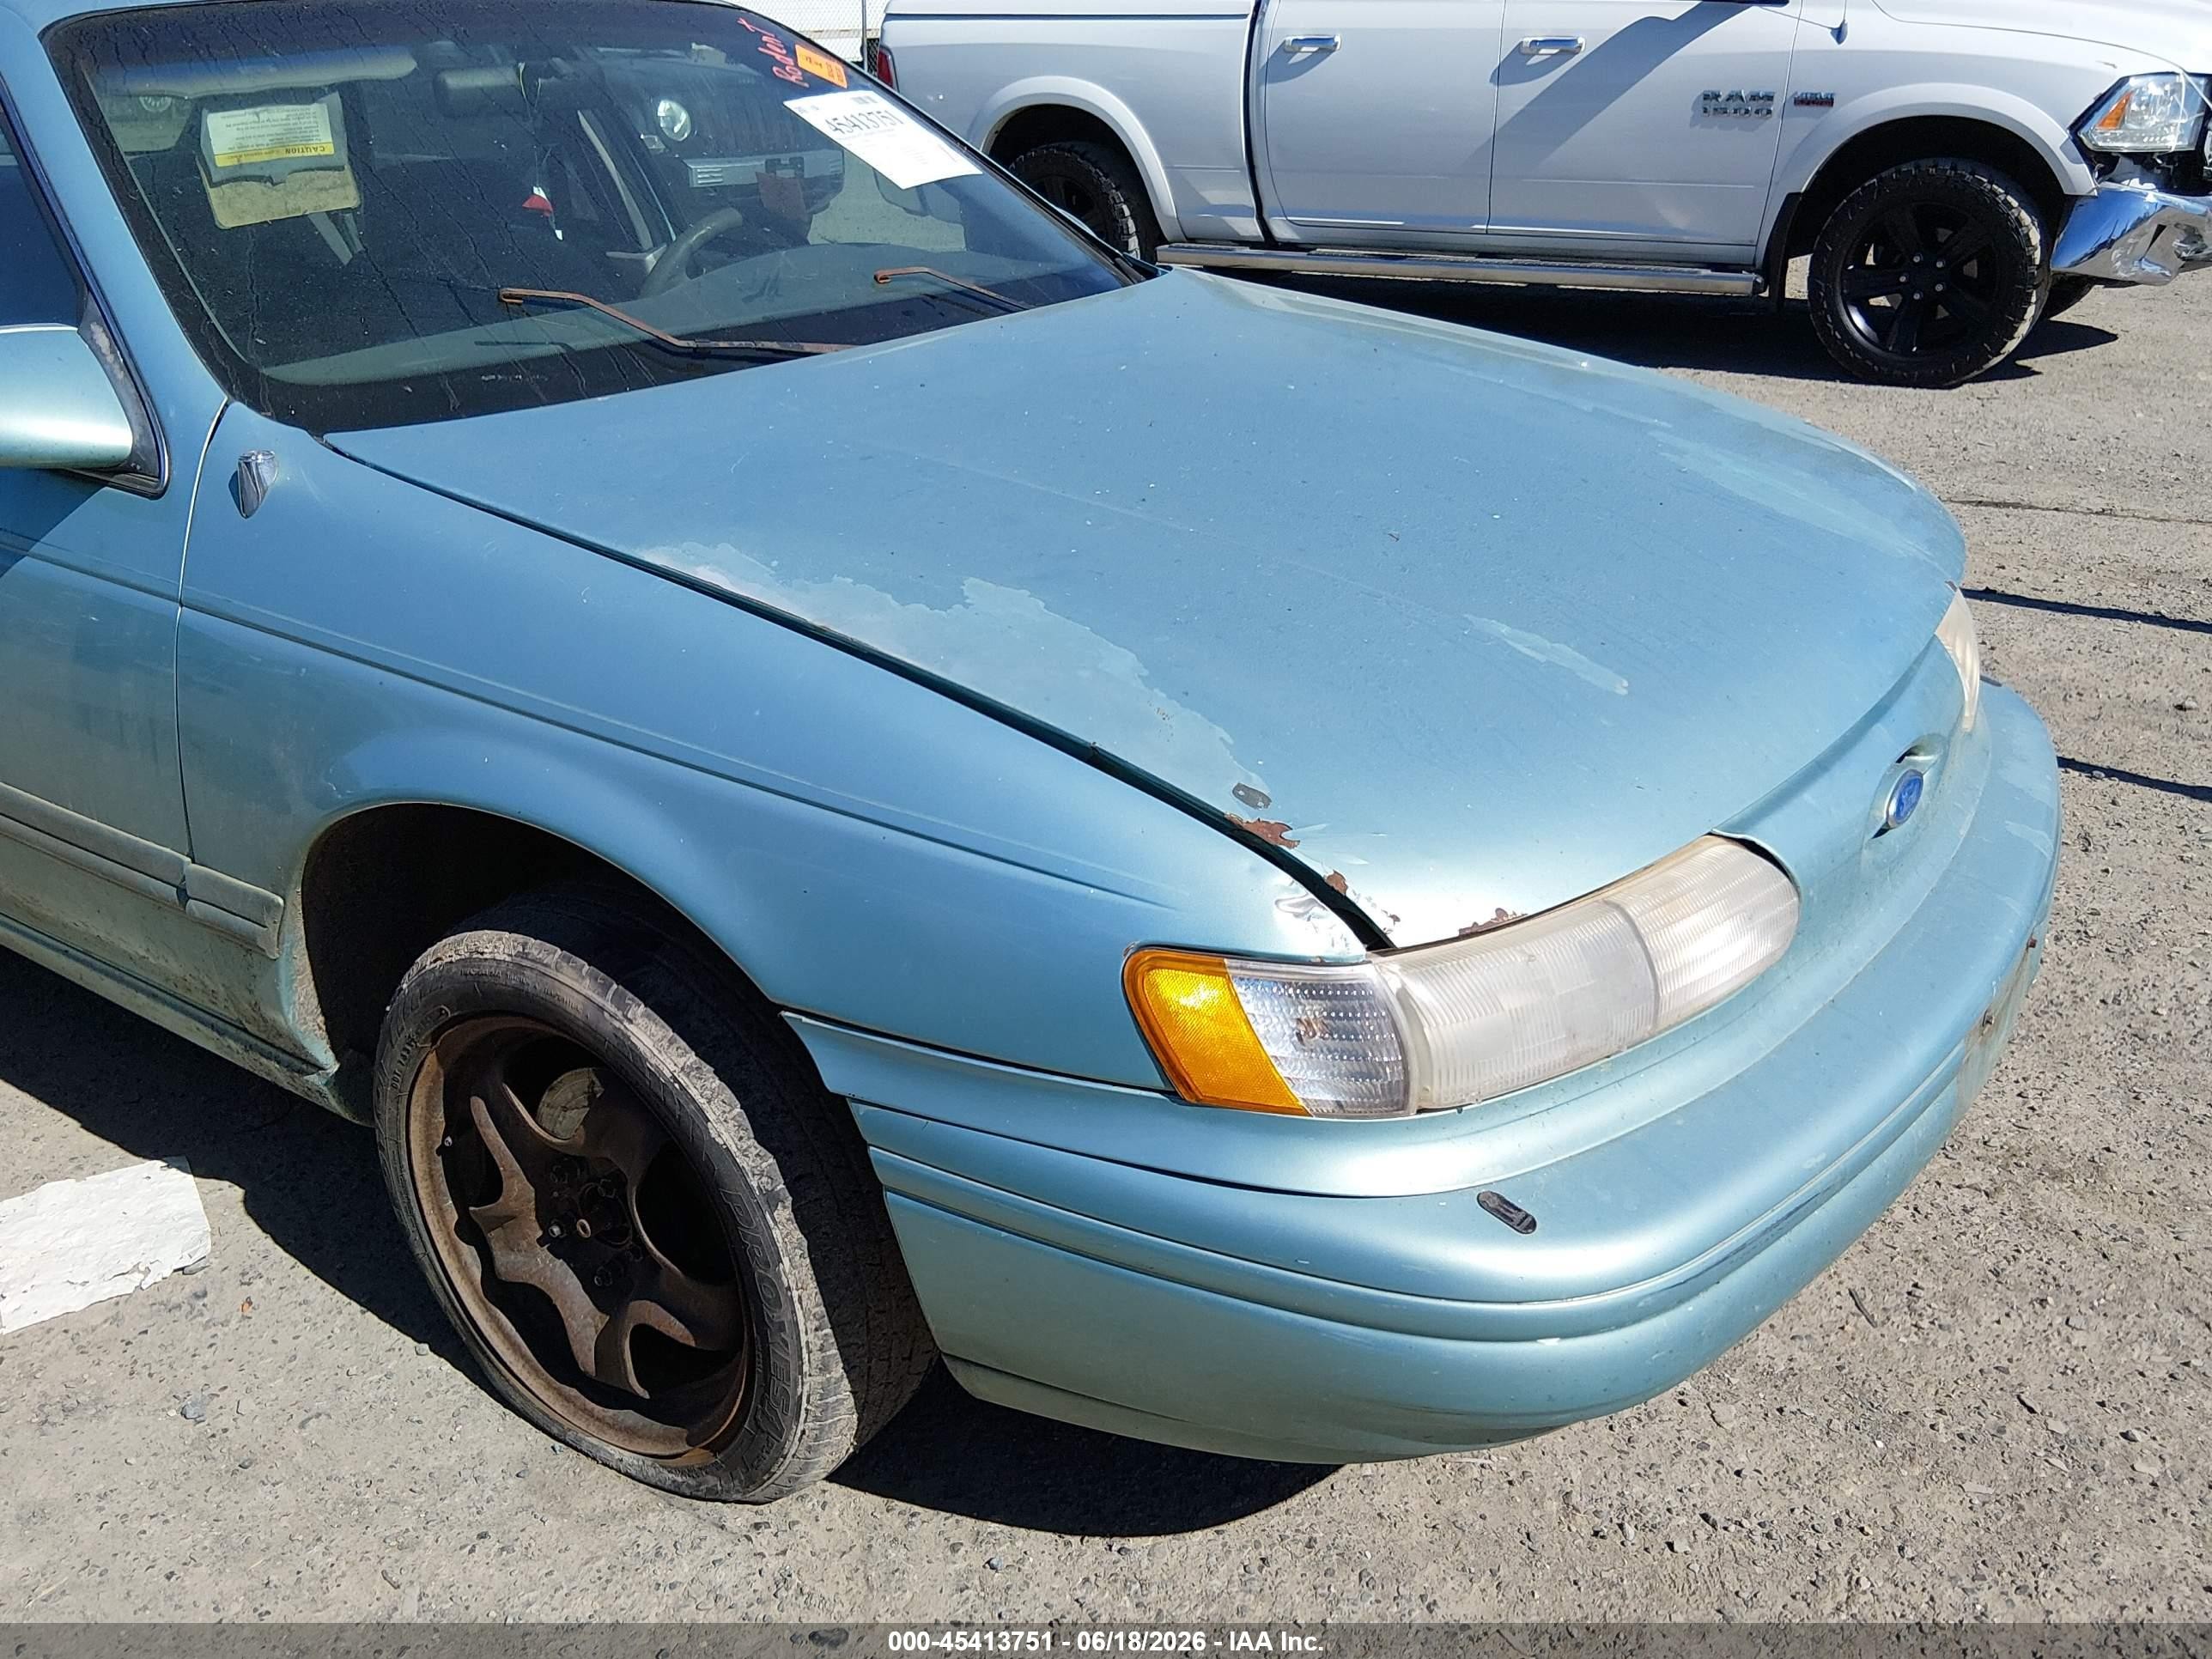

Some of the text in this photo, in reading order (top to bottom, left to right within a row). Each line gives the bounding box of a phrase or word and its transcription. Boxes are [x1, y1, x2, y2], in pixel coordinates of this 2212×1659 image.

[1703, 89, 1775, 103] RAM
[1703, 106, 1773, 118] 1500
[824, 109, 904, 135] 45413751
[284, 146, 326, 155] CAUTION
[719, 1188, 792, 1416] PROXES
